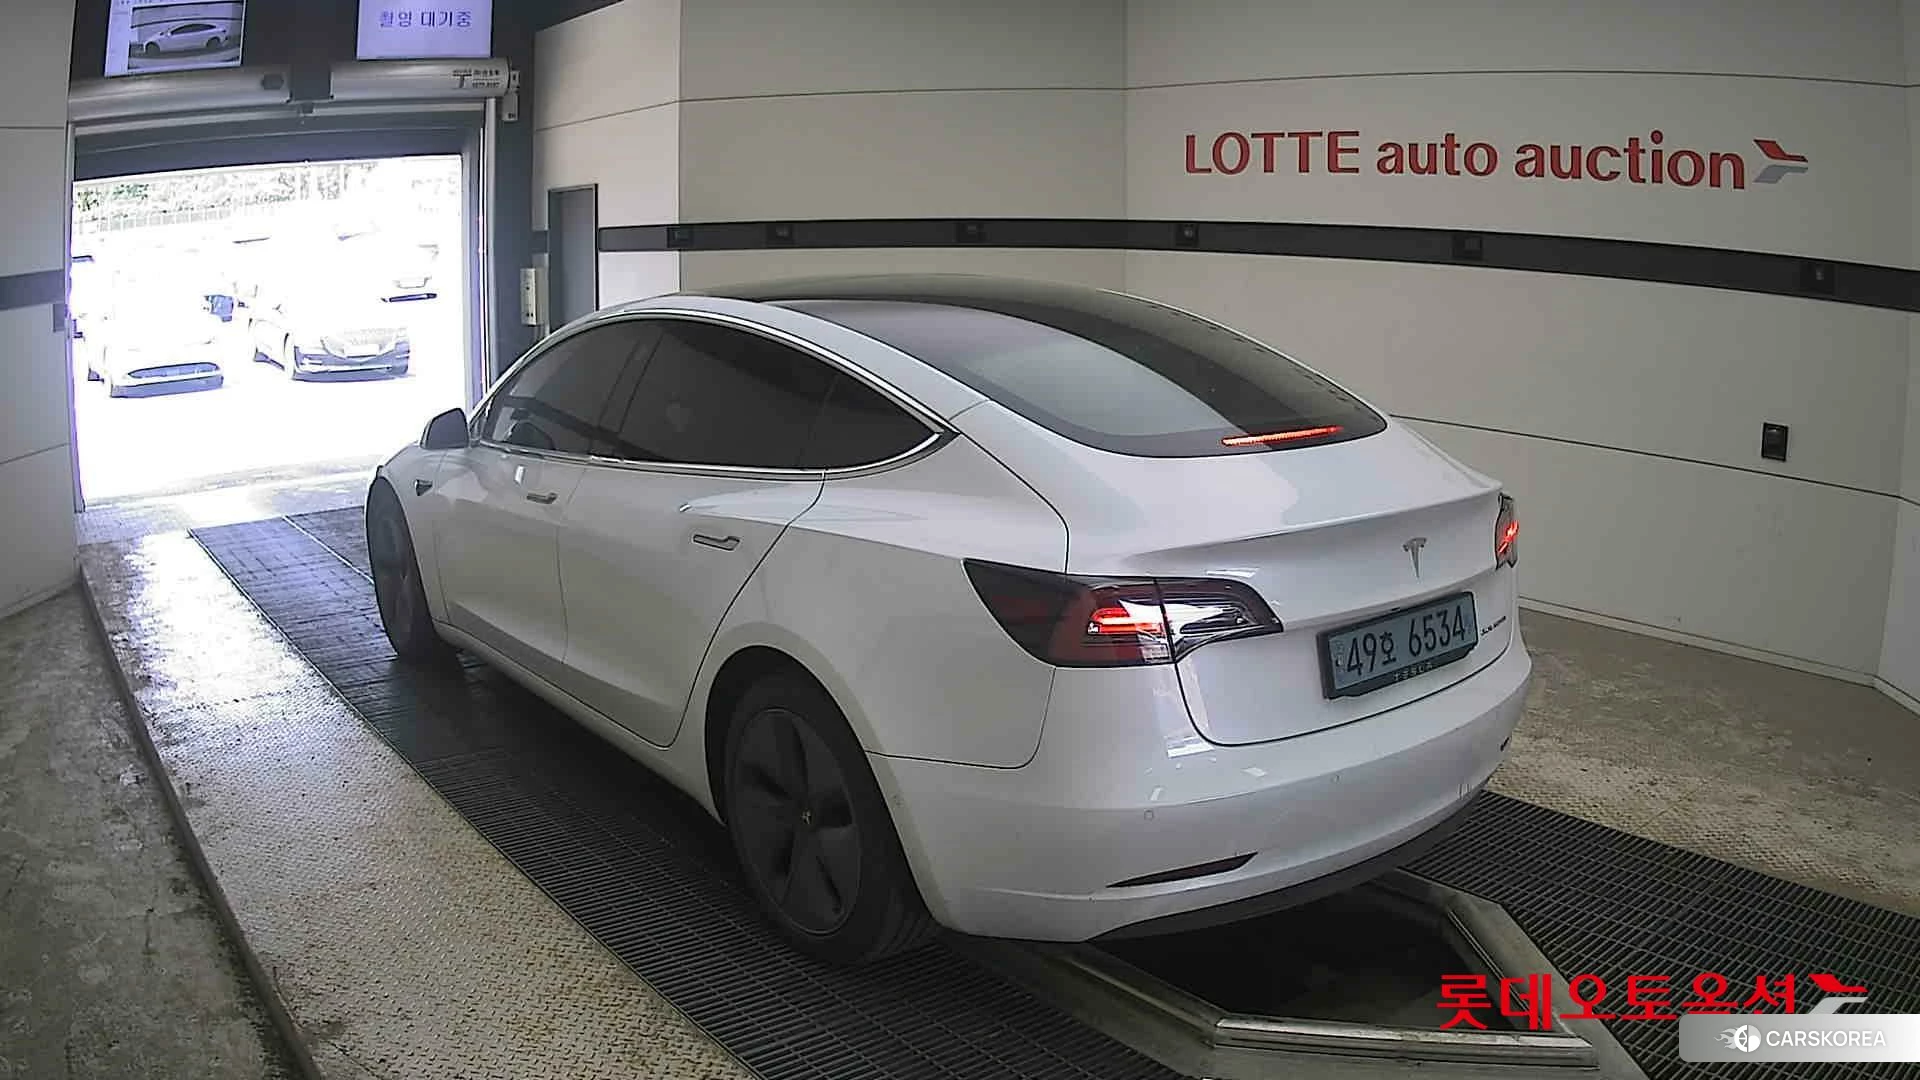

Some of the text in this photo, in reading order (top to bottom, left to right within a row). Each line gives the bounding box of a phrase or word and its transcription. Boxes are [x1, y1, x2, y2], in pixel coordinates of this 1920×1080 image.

[421, 10, 472, 28] 대기중
[1184, 130, 1745, 189] LOTTE auto auction
[1346, 631, 1397, 676] 49호
[1408, 605, 1465, 657] 6534
